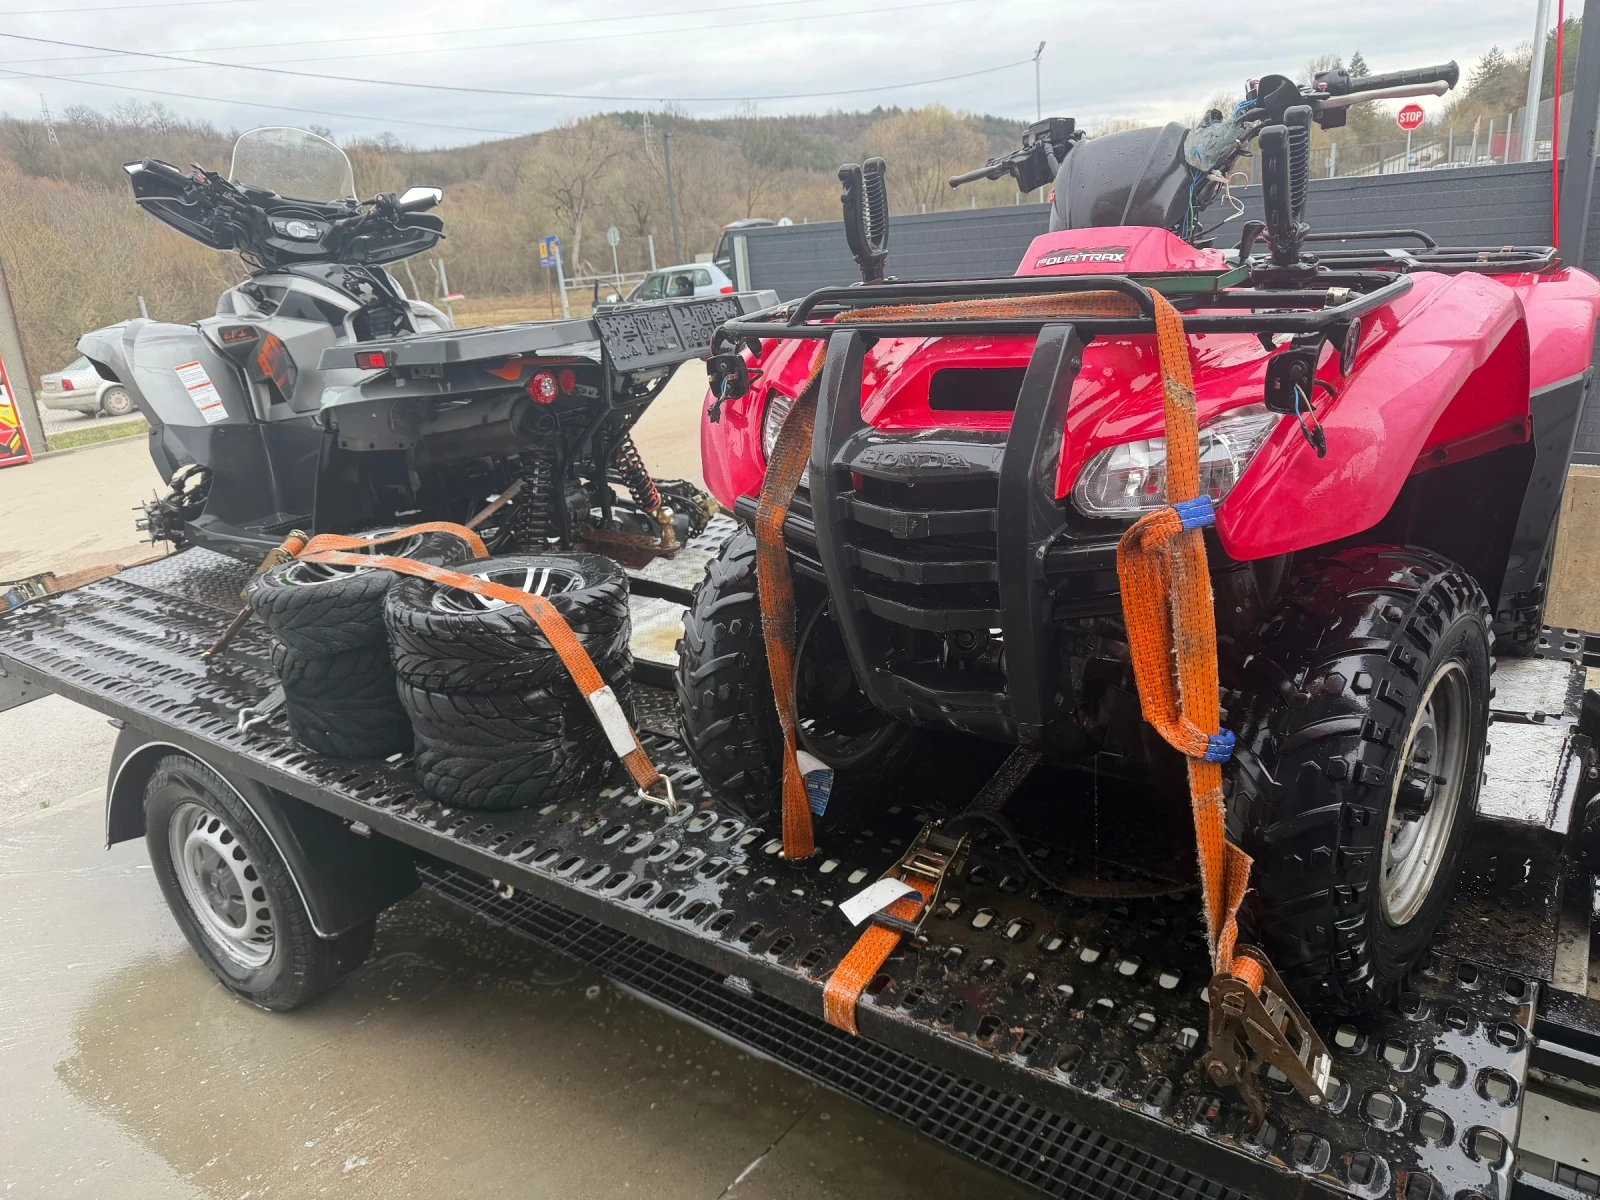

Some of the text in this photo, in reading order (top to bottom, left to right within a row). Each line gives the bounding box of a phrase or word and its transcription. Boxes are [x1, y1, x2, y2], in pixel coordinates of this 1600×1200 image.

[1400, 111, 1422, 122] STOP
[1036, 253, 1125, 267] FOURTRAX
[860, 449, 970, 468] HONDA
